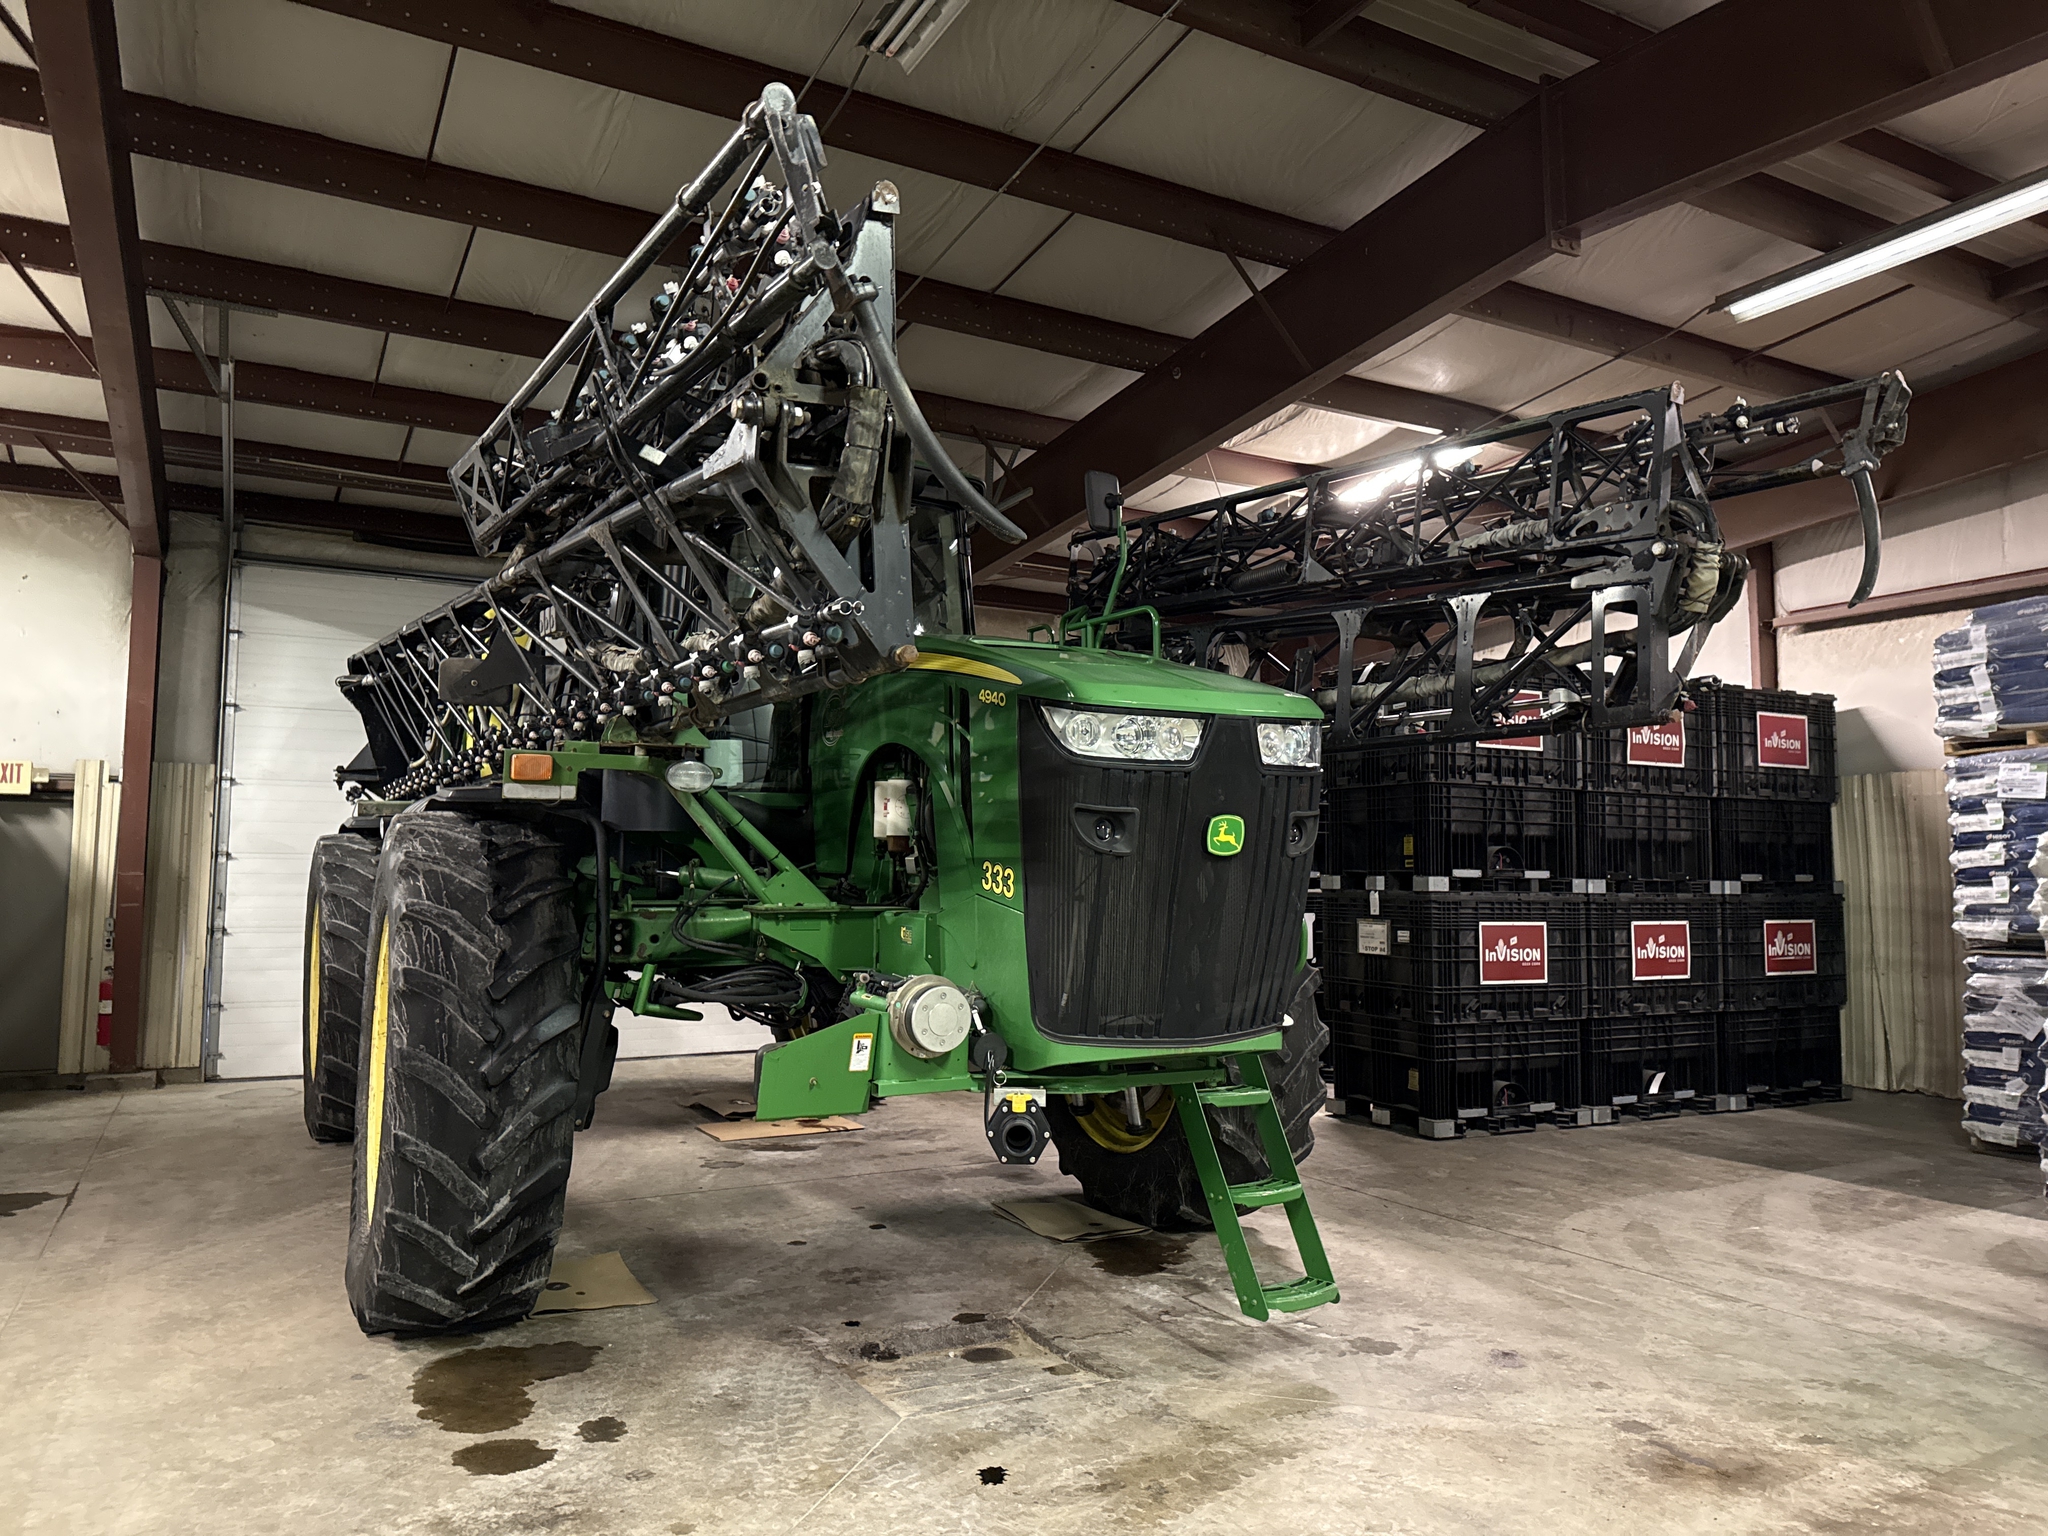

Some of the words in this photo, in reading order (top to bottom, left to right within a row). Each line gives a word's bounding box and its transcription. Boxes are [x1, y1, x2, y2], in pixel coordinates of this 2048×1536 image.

[978, 689, 1006, 707] 4940
[0, 763, 24, 784] XIT
[981, 860, 1015, 899] 333
[1485, 945, 1541, 962] InVISION
[1637, 943, 1685, 959] InVISION
